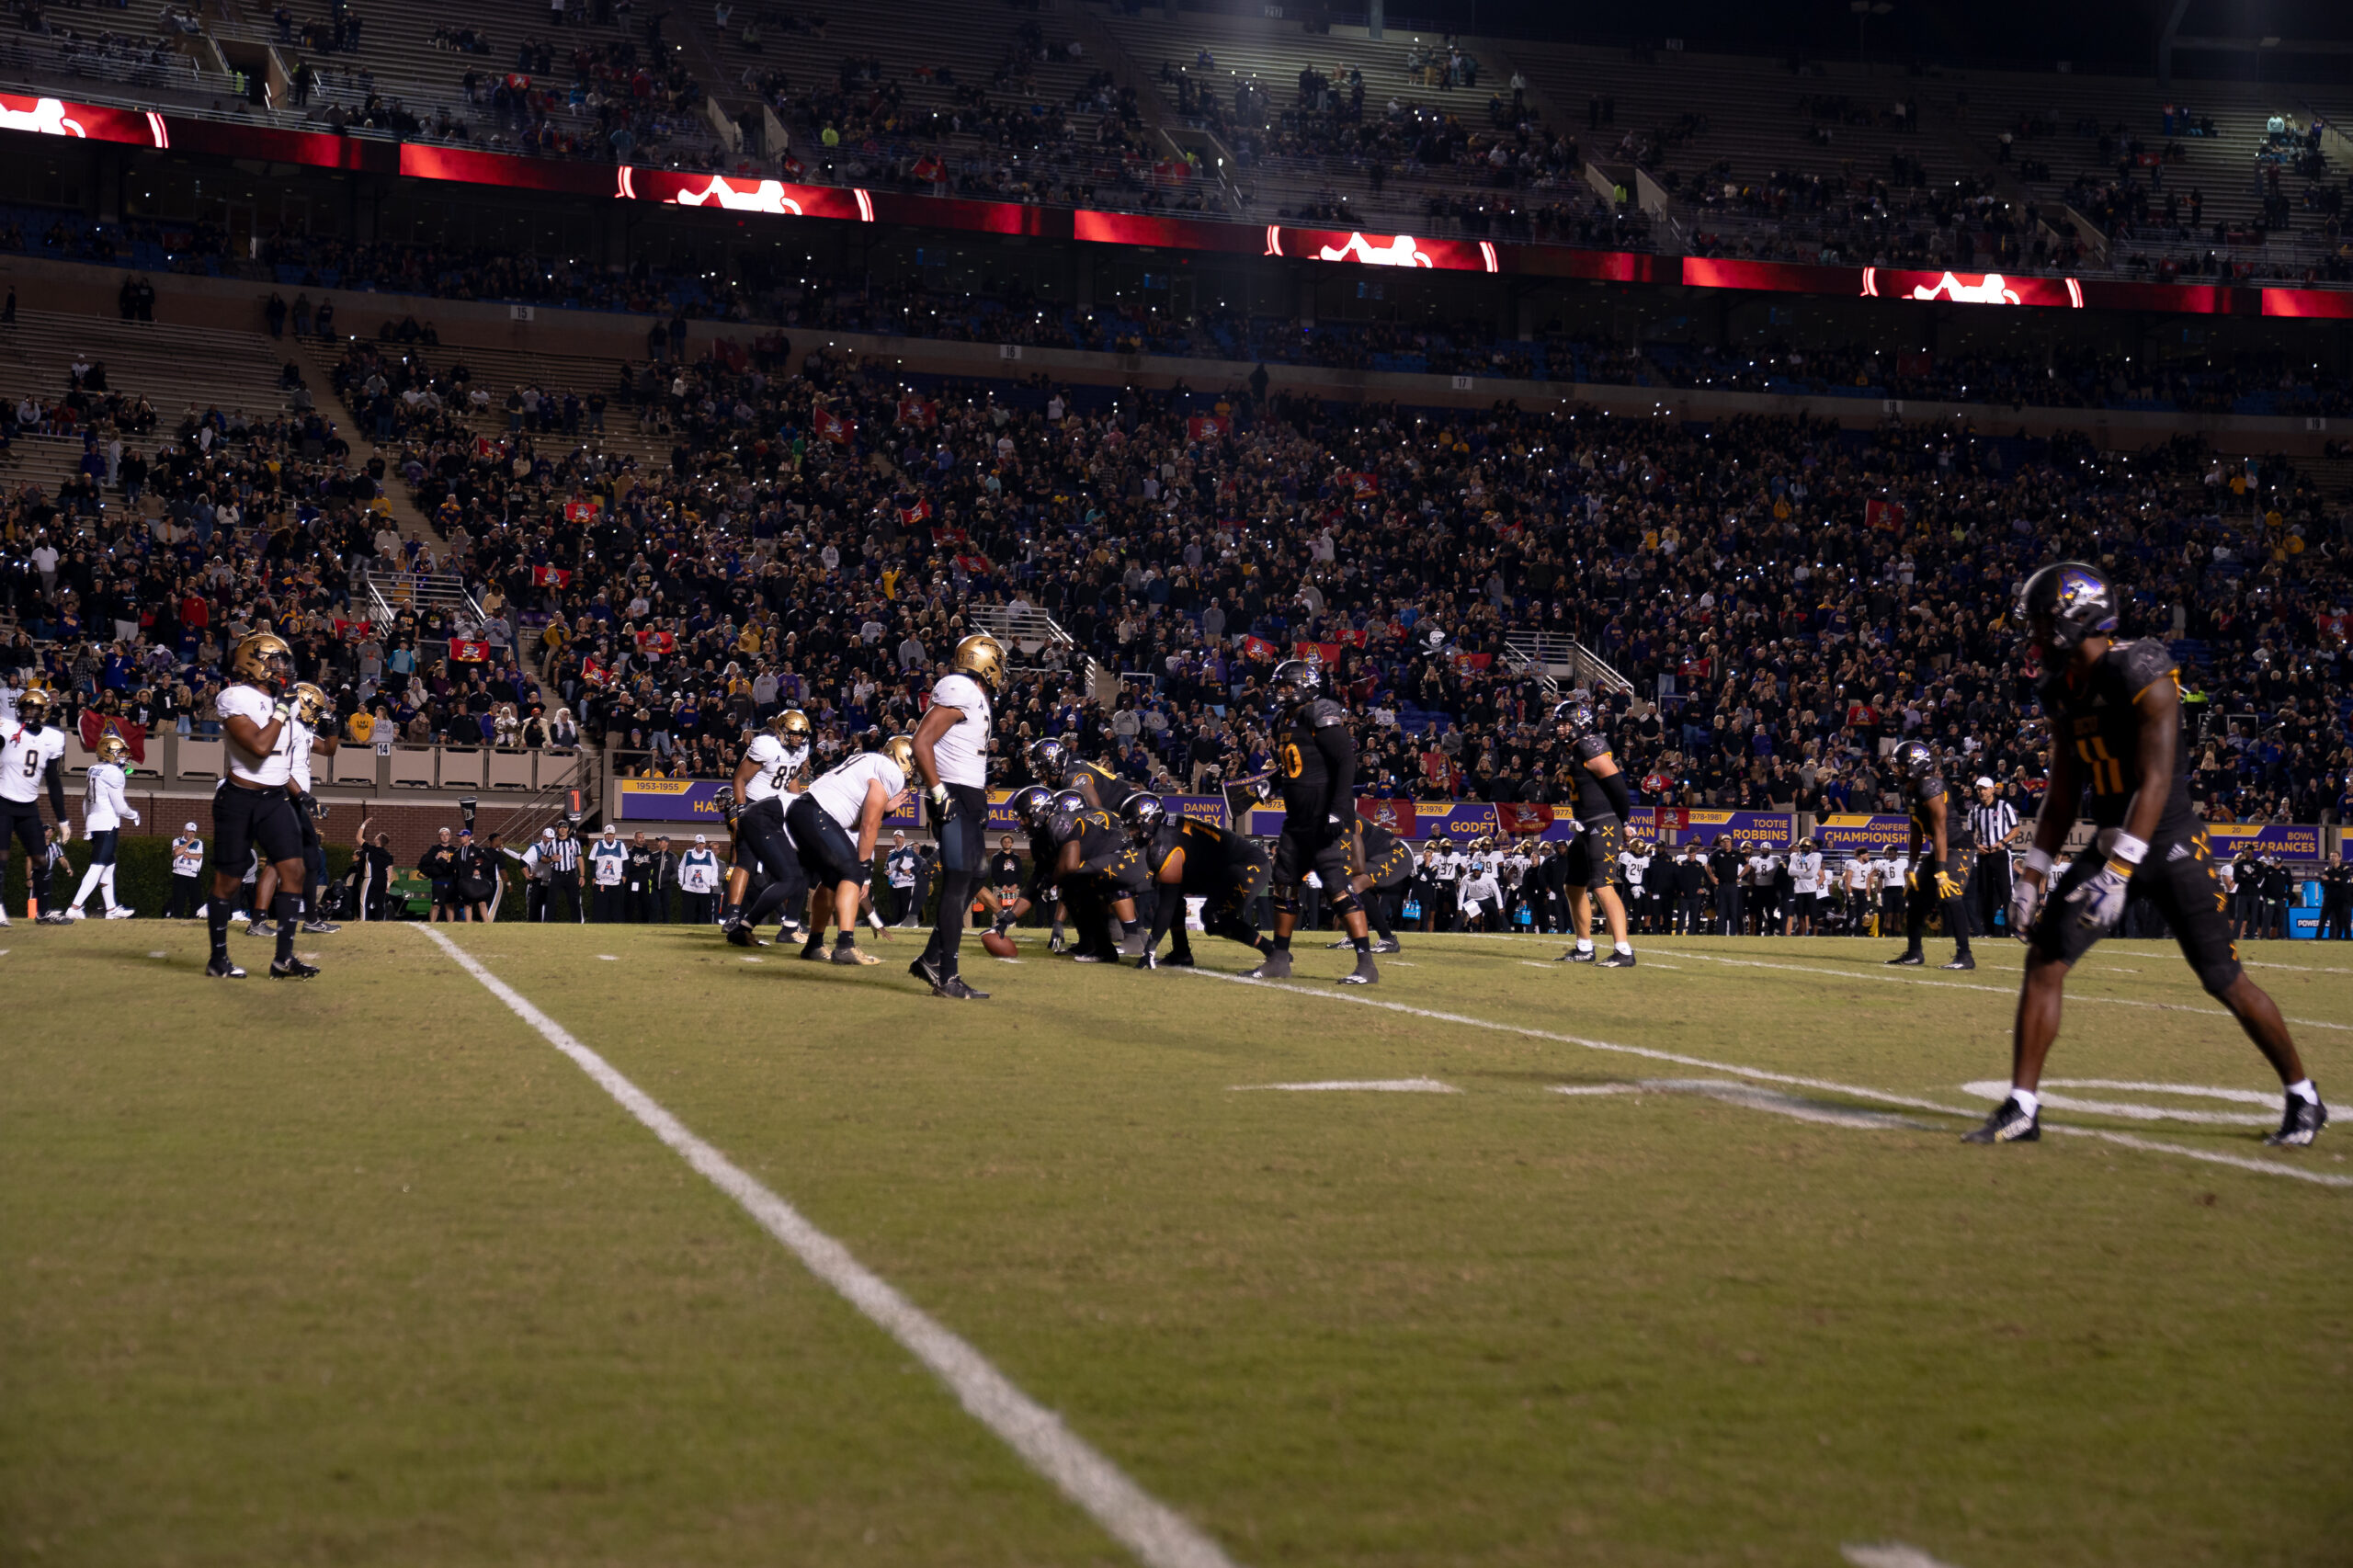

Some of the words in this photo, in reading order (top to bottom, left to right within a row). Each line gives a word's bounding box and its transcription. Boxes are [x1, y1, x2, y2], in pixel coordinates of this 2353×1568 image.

[517, 307, 528, 319] 15
[1006, 346, 1016, 358] 16
[1459, 378, 1467, 388] 17
[2313, 418, 2321, 428] 19
[165, 696, 172, 709] 1
[786, 699, 800, 708] ECU
[379, 744, 388, 755] 14
[23, 749, 38, 778] 9
[2075, 735, 2124, 796] 11
[771, 766, 797, 790] 88
[636, 782, 679, 790] 1953-1955
[571, 790, 580, 812] 1
[694, 801, 720, 812] HA
[1184, 803, 1222, 812] DANNY
[1628, 816, 1654, 825] AYNE
[1753, 819, 1789, 829] TOOTIE
[1450, 822, 1495, 833] GODET
[1870, 824, 1910, 832] CONFERE
[1733, 829, 1789, 841] ROBBINS
[2287, 832, 2315, 840] BOWL
[1440, 863, 1453, 875] 37
[1630, 864, 1643, 876] 24
[1761, 865, 1768, 876] 8
[1889, 867, 1895, 879] 6
[1860, 870, 1866, 882] 5
